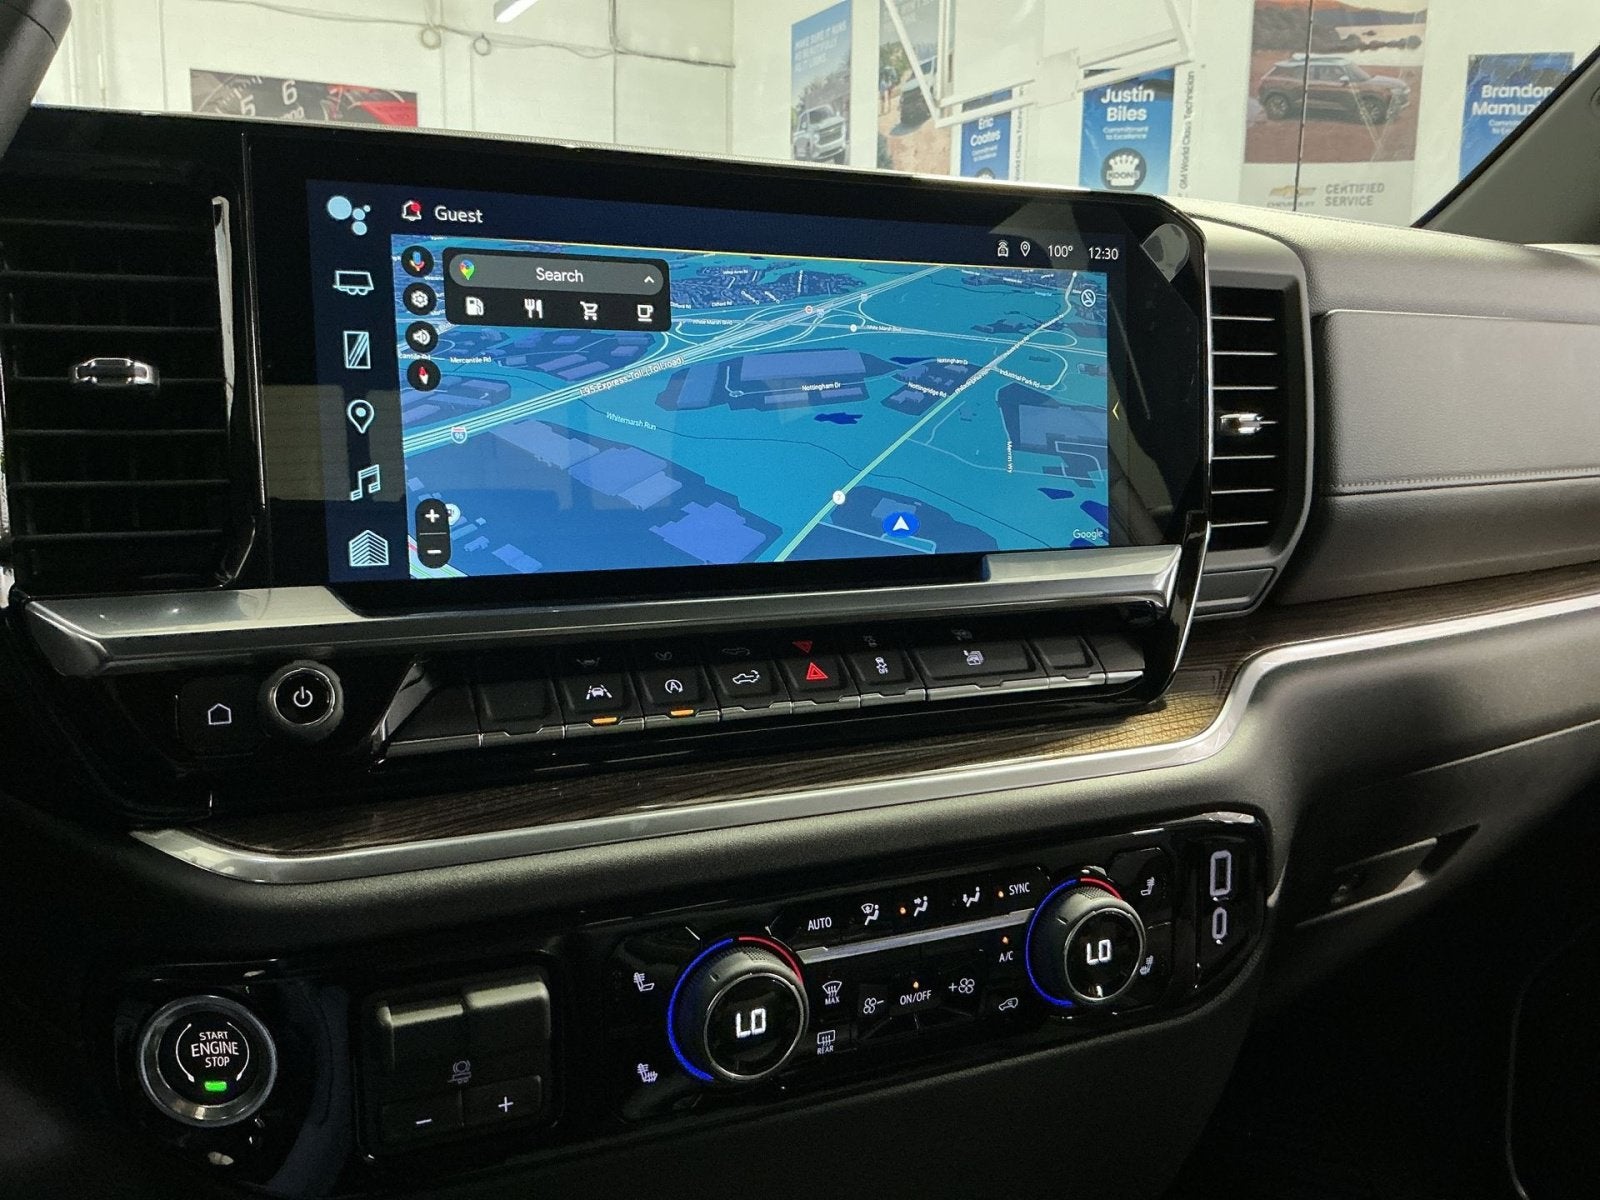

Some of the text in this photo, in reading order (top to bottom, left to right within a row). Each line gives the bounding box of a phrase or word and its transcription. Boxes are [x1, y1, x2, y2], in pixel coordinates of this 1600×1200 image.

[282, 80, 297, 105] 6
[1101, 85, 1155, 103] Justin
[1106, 105, 1147, 122] Biles
[1325, 183, 1385, 194] CERTIFIED
[1325, 196, 1374, 207] SERVICE
[434, 205, 484, 224] Guest
[1048, 244, 1074, 258] 100°
[1089, 247, 1119, 260] 12:30
[535, 266, 584, 284] Search
[450, 356, 482, 364] Mercantile
[597, 375, 630, 391] Express
[607, 412, 657, 430] Whitemarsh Run
[454, 432, 464, 440] 95
[1072, 529, 1103, 541] Google
[1008, 882, 1030, 896] SYNC
[807, 917, 832, 931] AUTO
[999, 951, 1014, 963] A/C
[825, 996, 840, 1005] MAX
[900, 990, 932, 1006] ON/OFF
[199, 1031, 229, 1041] START
[190, 1041, 240, 1058] ENGINE
[205, 1056, 230, 1068] STOP
